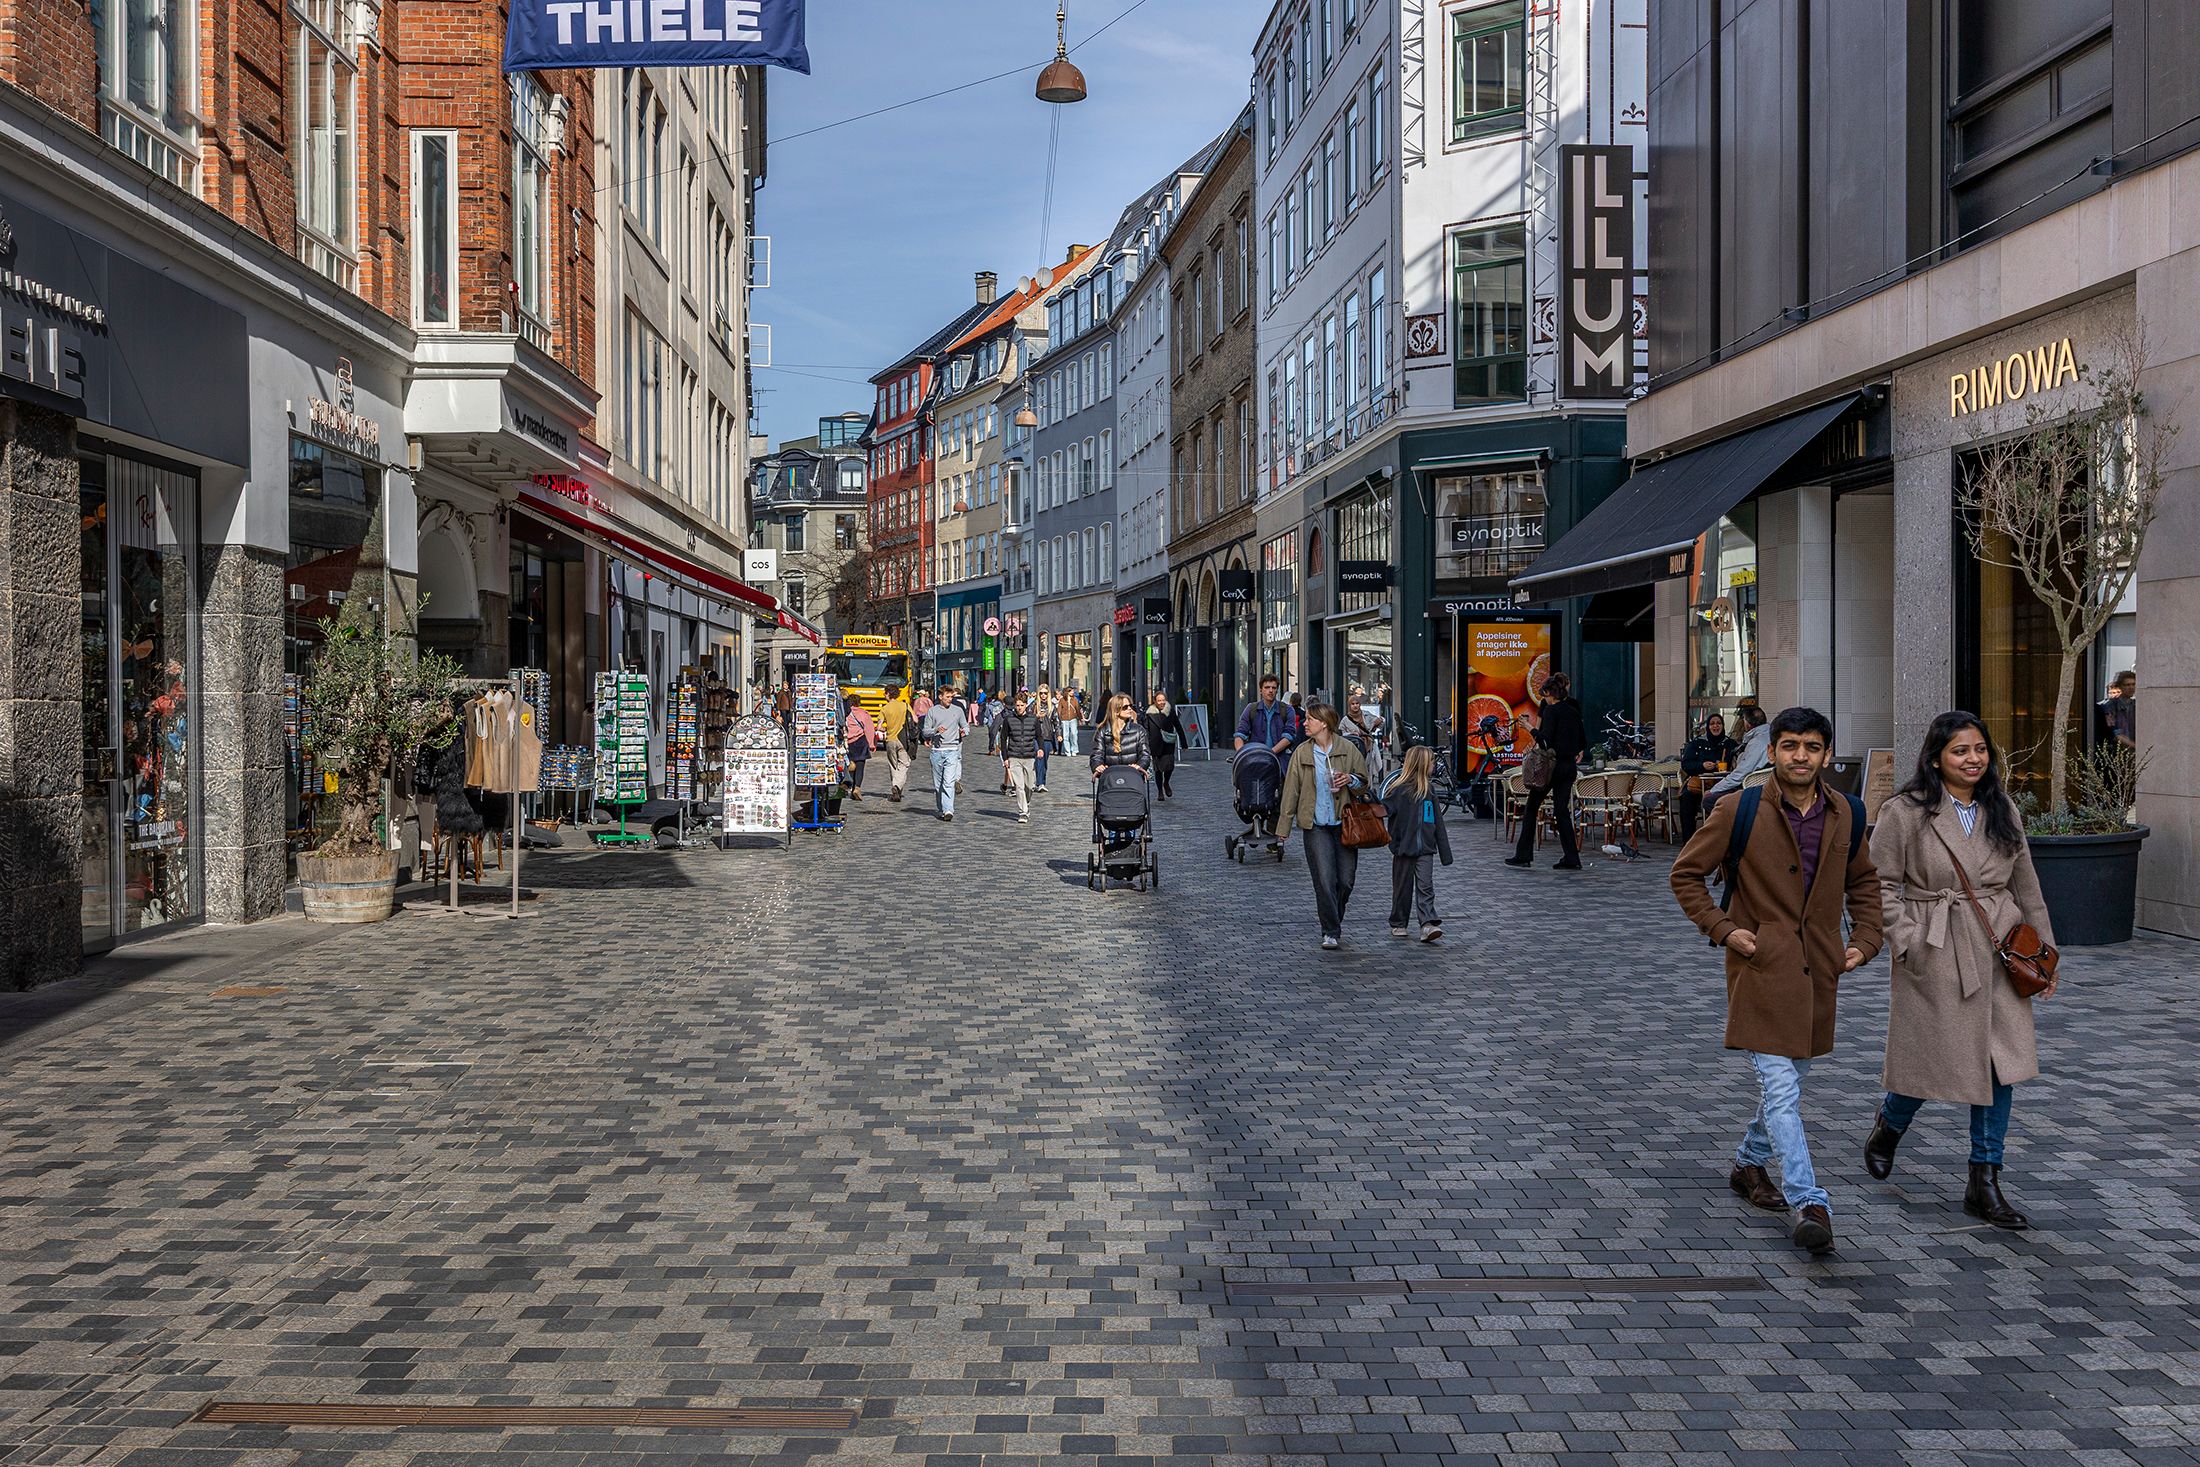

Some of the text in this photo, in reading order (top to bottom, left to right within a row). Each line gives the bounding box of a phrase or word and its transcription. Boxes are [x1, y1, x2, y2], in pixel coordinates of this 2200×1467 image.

[546, 1, 762, 45] THIELE
[1572, 155, 1624, 387] ILLUM
[1951, 338, 2079, 417] RIMOWA
[1457, 522, 1543, 543] synoptik
[751, 561, 770, 569] COS
[1669, 552, 1687, 574] HOLM
[1342, 571, 1383, 580] synoptik
[1222, 588, 1247, 600] CeriX
[1145, 612, 1166, 623] CeriX
[1476, 632, 1521, 641] Appelsiner
[1476, 640, 1528, 649] smager ikke
[792, 652, 808, 660] HOME
[1476, 649, 1520, 658] af appelsin
